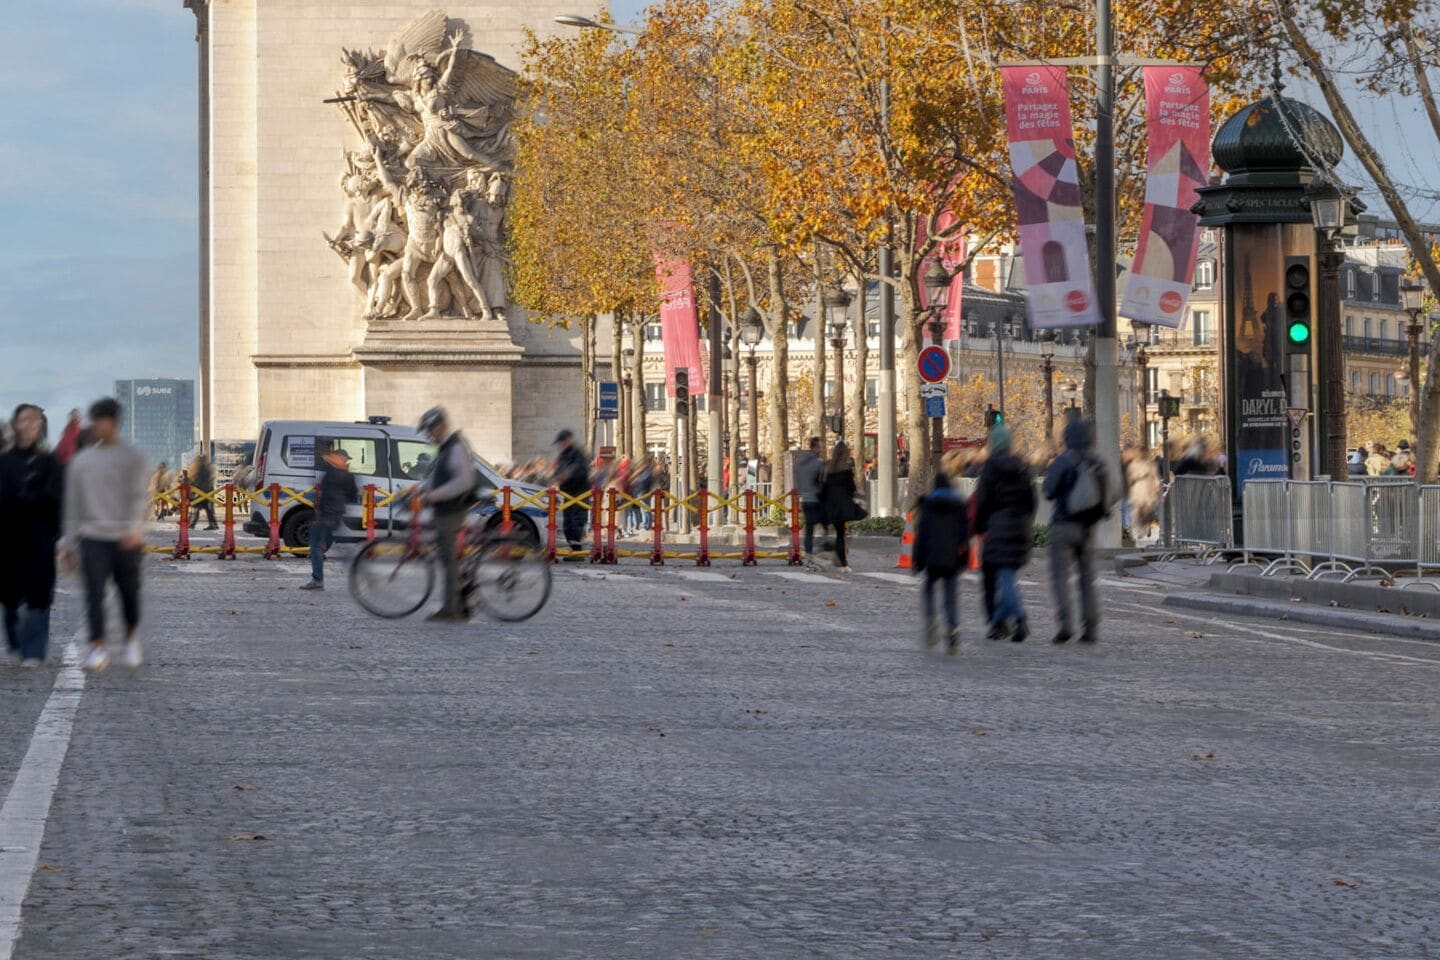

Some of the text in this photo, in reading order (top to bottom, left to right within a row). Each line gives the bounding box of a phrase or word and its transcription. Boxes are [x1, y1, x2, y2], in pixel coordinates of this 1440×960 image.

[1022, 87, 1048, 95] PARIS
[1164, 86, 1191, 95] PARIS
[1017, 103, 1058, 112] Partagez
[1018, 111, 1059, 121] la magie
[1160, 109, 1168, 117] la
[1019, 120, 1035, 129] des
[1160, 117, 1176, 126] des
[1242, 398, 1277, 416] DARYL
